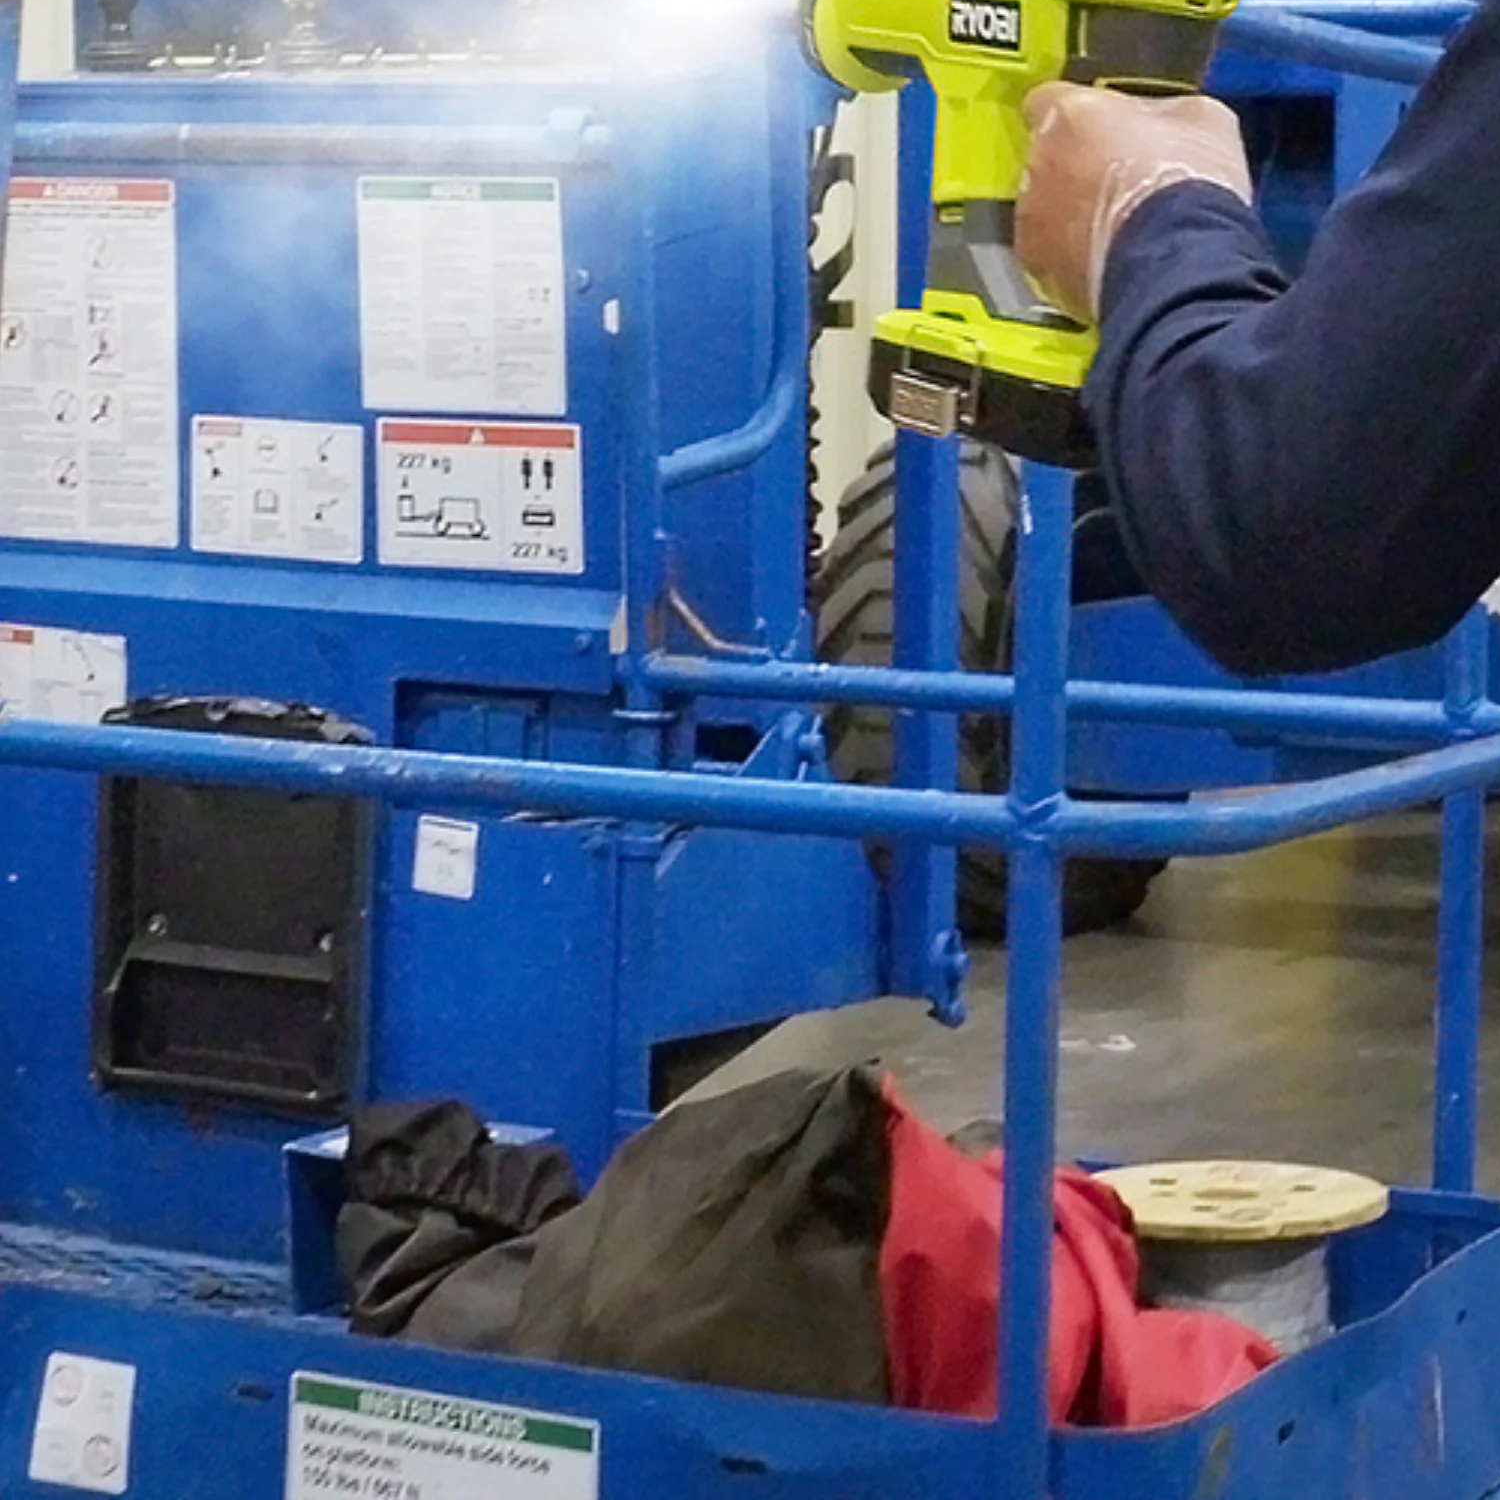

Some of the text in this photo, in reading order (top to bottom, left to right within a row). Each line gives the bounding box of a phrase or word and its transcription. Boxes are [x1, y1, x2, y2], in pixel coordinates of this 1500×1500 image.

[951, 0, 1019, 42] RYOBI
[397, 452, 426, 468] 227
[511, 541, 542, 558] 227
